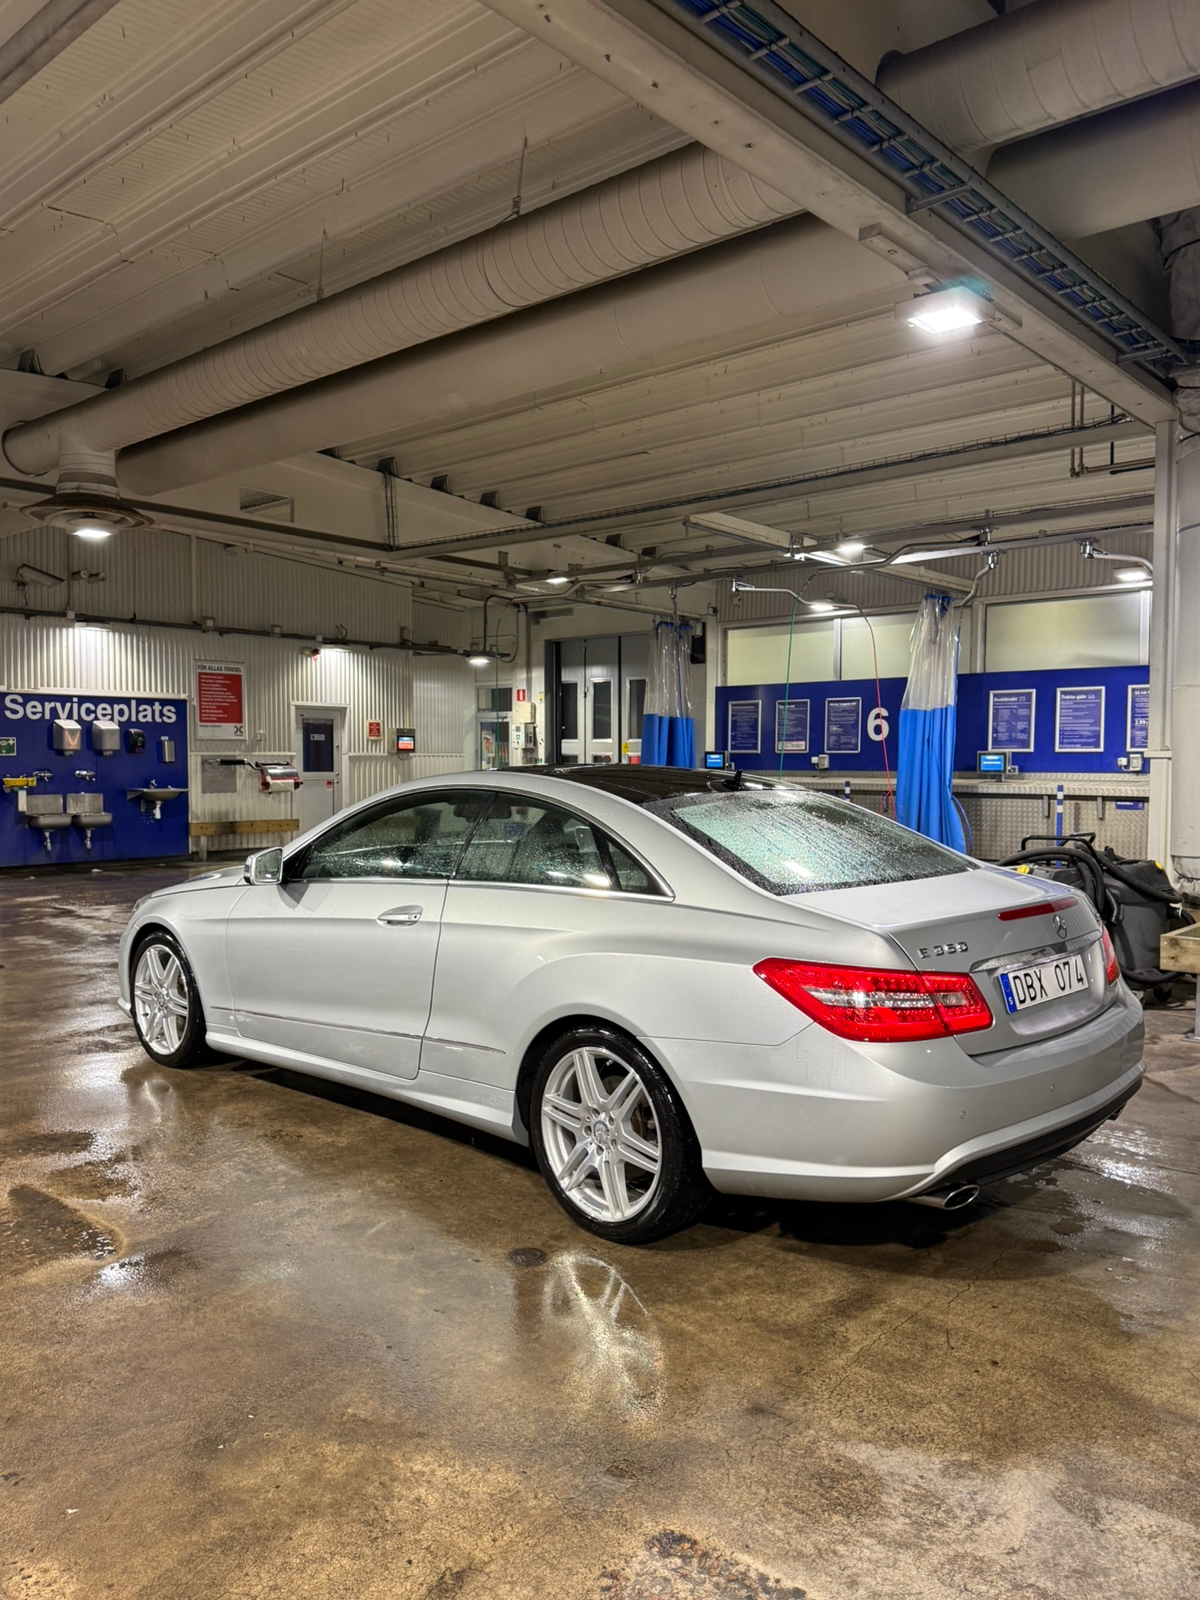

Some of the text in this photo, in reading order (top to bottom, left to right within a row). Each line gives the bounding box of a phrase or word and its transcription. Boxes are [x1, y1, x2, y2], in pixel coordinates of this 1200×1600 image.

[4, 694, 177, 724] Serviceplats
[866, 707, 890, 742] 6
[918, 942, 969, 959] E 350
[1012, 969, 1048, 1004] DBX
[1054, 958, 1084, 990] 074
